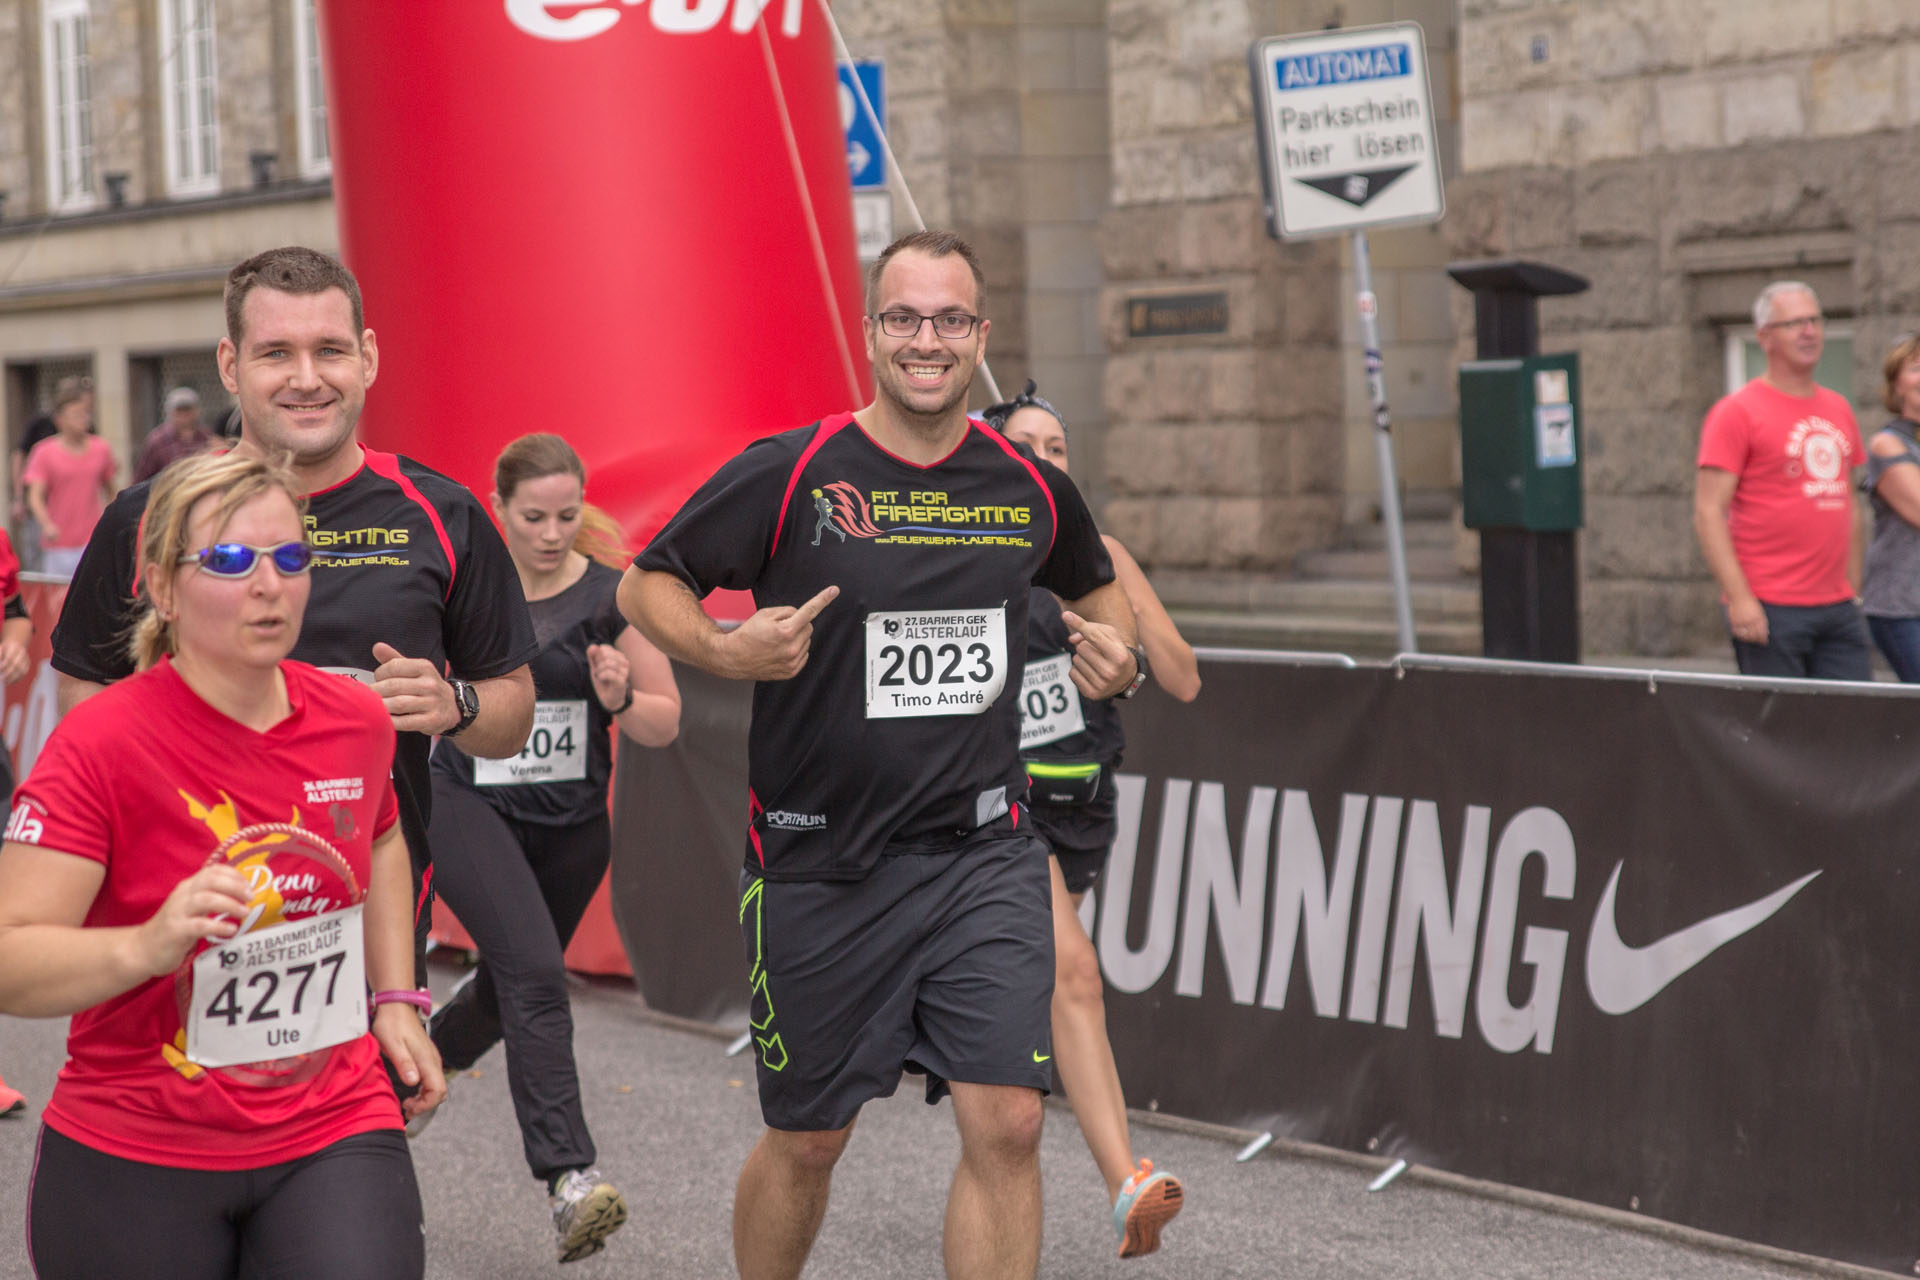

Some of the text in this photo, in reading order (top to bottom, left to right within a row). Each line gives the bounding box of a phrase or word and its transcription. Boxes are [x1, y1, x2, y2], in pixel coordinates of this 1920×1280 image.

[1282, 48, 1405, 88] AUTOMAT
[1279, 95, 1421, 133] Parkschein
[1285, 131, 1424, 168] hier lösen
[871, 491, 948, 505] FIT FOR
[873, 505, 1031, 525] FIREFIGHTING
[905, 617, 918, 626] 27.
[920, 616, 965, 626] BARMER
[966, 615, 988, 625] GEK
[905, 625, 988, 640] ALSTERLAUF
[879, 642, 994, 687] 2023
[891, 690, 984, 707] Timo André
[1021, 683, 1069, 723] 03
[510, 765, 552, 776] Verena
[307, 787, 364, 804] ALSTERLAUF
[244, 864, 321, 894] Denn
[1080, 774, 1577, 1053] UNNING
[246, 941, 263, 954] 27.
[264, 927, 318, 950] BARMER
[318, 918, 342, 932] GEK
[246, 930, 342, 968] ALSTERLAUF
[206, 950, 346, 1026] 4277
[267, 1028, 300, 1047] Ute
